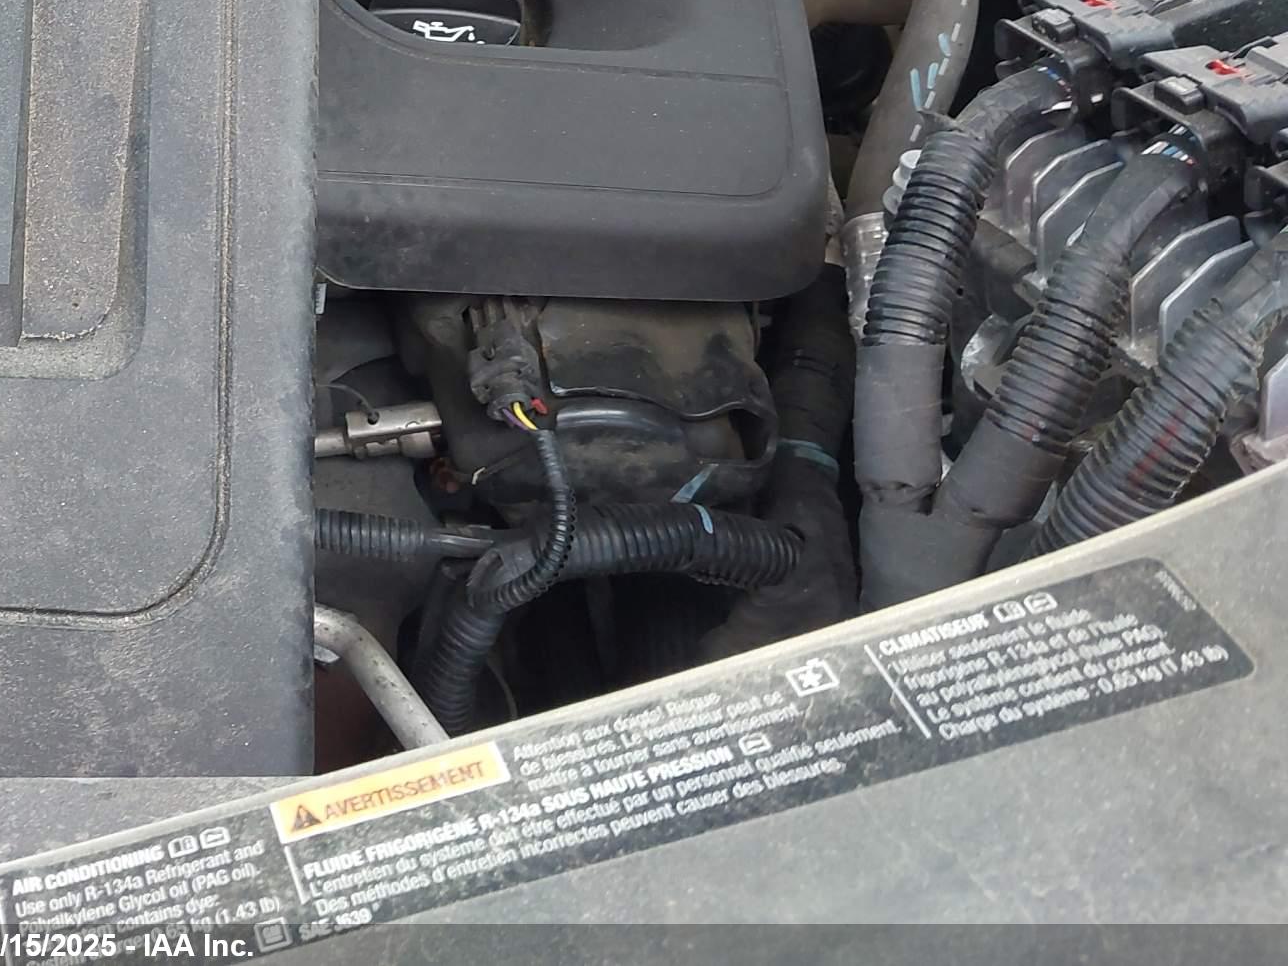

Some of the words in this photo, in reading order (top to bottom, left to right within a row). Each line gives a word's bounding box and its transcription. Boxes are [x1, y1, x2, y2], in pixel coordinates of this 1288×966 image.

[880, 614, 987, 655] CLIMATISEUR
[988, 639, 1049, 666] R-134a
[1049, 633, 1067, 648] et
[1068, 628, 1089, 643] de
[917, 691, 939, 706] au
[927, 707, 950, 723] Le
[952, 688, 1017, 716] système
[1019, 668, 1083, 696] contient
[1083, 662, 1106, 678] du
[1107, 643, 1174, 671] colorant.
[939, 712, 997, 740] Charge
[999, 706, 1022, 722] du
[1023, 687, 1089, 717] système
[1136, 664, 1162, 682] kg
[514, 732, 580, 760] Attention
[582, 724, 611, 740] aux
[520, 758, 540, 775] de
[621, 727, 649, 748] Le
[727, 696, 762, 720] peut
[763, 692, 783, 706] se
[322, 759, 487, 819] AVERTISSEMENT
[526, 768, 578, 791] mettre
[581, 762, 593, 776] à
[594, 748, 648, 773] tourner
[653, 737, 691, 756] sans
[304, 850, 364, 878] FLUIDE
[366, 816, 476, 860] FRIGORIGÈNE
[479, 803, 540, 830] R-134a
[542, 787, 589, 812] SOUS
[590, 770, 647, 798] HAUTE
[648, 747, 732, 782] PRESSION
[310, 864, 393, 896] L'entretien
[396, 858, 417, 874] du
[420, 838, 486, 867] système
[489, 827, 519, 848] doit
[522, 817, 554, 837] être
[557, 798, 620, 828] effectué
[622, 791, 649, 812] par
[652, 785, 674, 801] un
[677, 761, 753, 796] personnel
[756, 744, 812, 771] qualifié
[816, 720, 900, 753] seulement.
[13, 876, 43, 895] AIR
[45, 846, 163, 888] CONDITIONING
[315, 896, 349, 915] Des
[351, 872, 430, 905] méthodes
[433, 849, 517, 882] d'entretien
[519, 823, 608, 857] incorrectes
[610, 804, 674, 835] peuvent
[677, 789, 728, 814] causer
[733, 779, 764, 798] des
[16, 900, 45, 917] Use
[49, 892, 82, 911] only
[85, 876, 143, 900] R-134a
[146, 851, 230, 883] Refrigerant
[235, 840, 264, 860] and
[18, 899, 117, 941] Polyalkylene
[119, 887, 166, 912] Glycol
[169, 881, 189, 898] oil
[192, 869, 230, 893] (PAG
[232, 863, 261, 880] oil).
[116, 904, 184, 932] contains
[215, 901, 257, 927] (1.43
[259, 896, 280, 914] lb)
[299, 918, 332, 940] SAE
